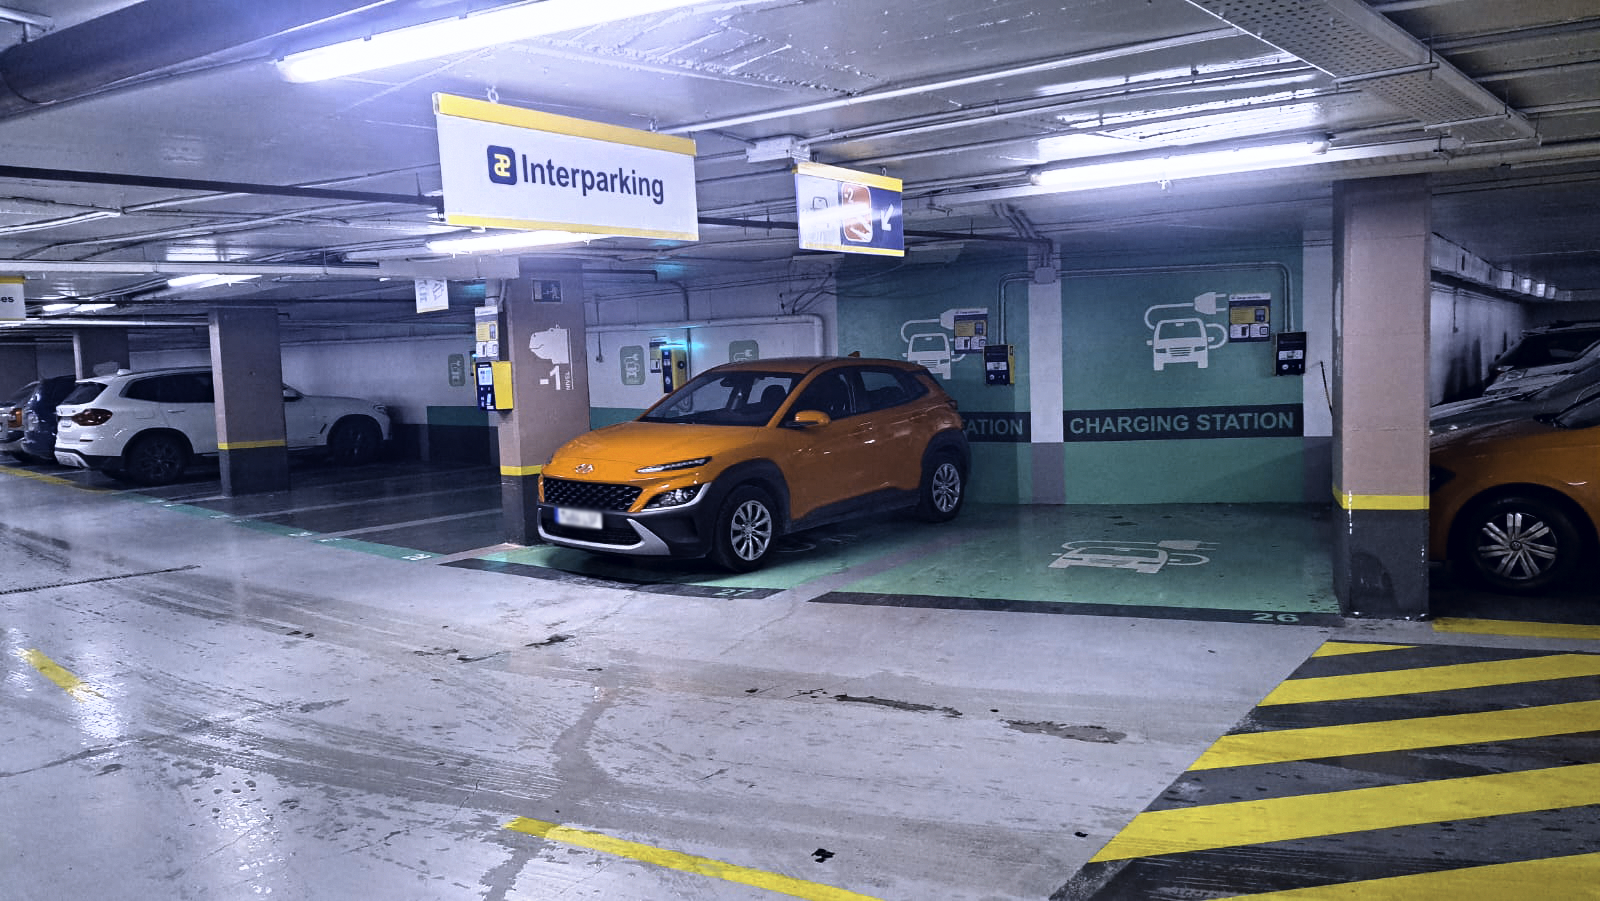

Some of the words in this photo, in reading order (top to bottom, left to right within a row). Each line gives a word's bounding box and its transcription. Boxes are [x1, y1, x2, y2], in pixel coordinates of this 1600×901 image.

[522, 154, 664, 205] Interparking
[540, 365, 560, 390] -1
[963, 419, 1023, 435] ATION
[1069, 415, 1190, 434] CHARGING
[1196, 412, 1294, 431] STATION
[712, 588, 755, 597] 27
[1251, 612, 1299, 622] 26
